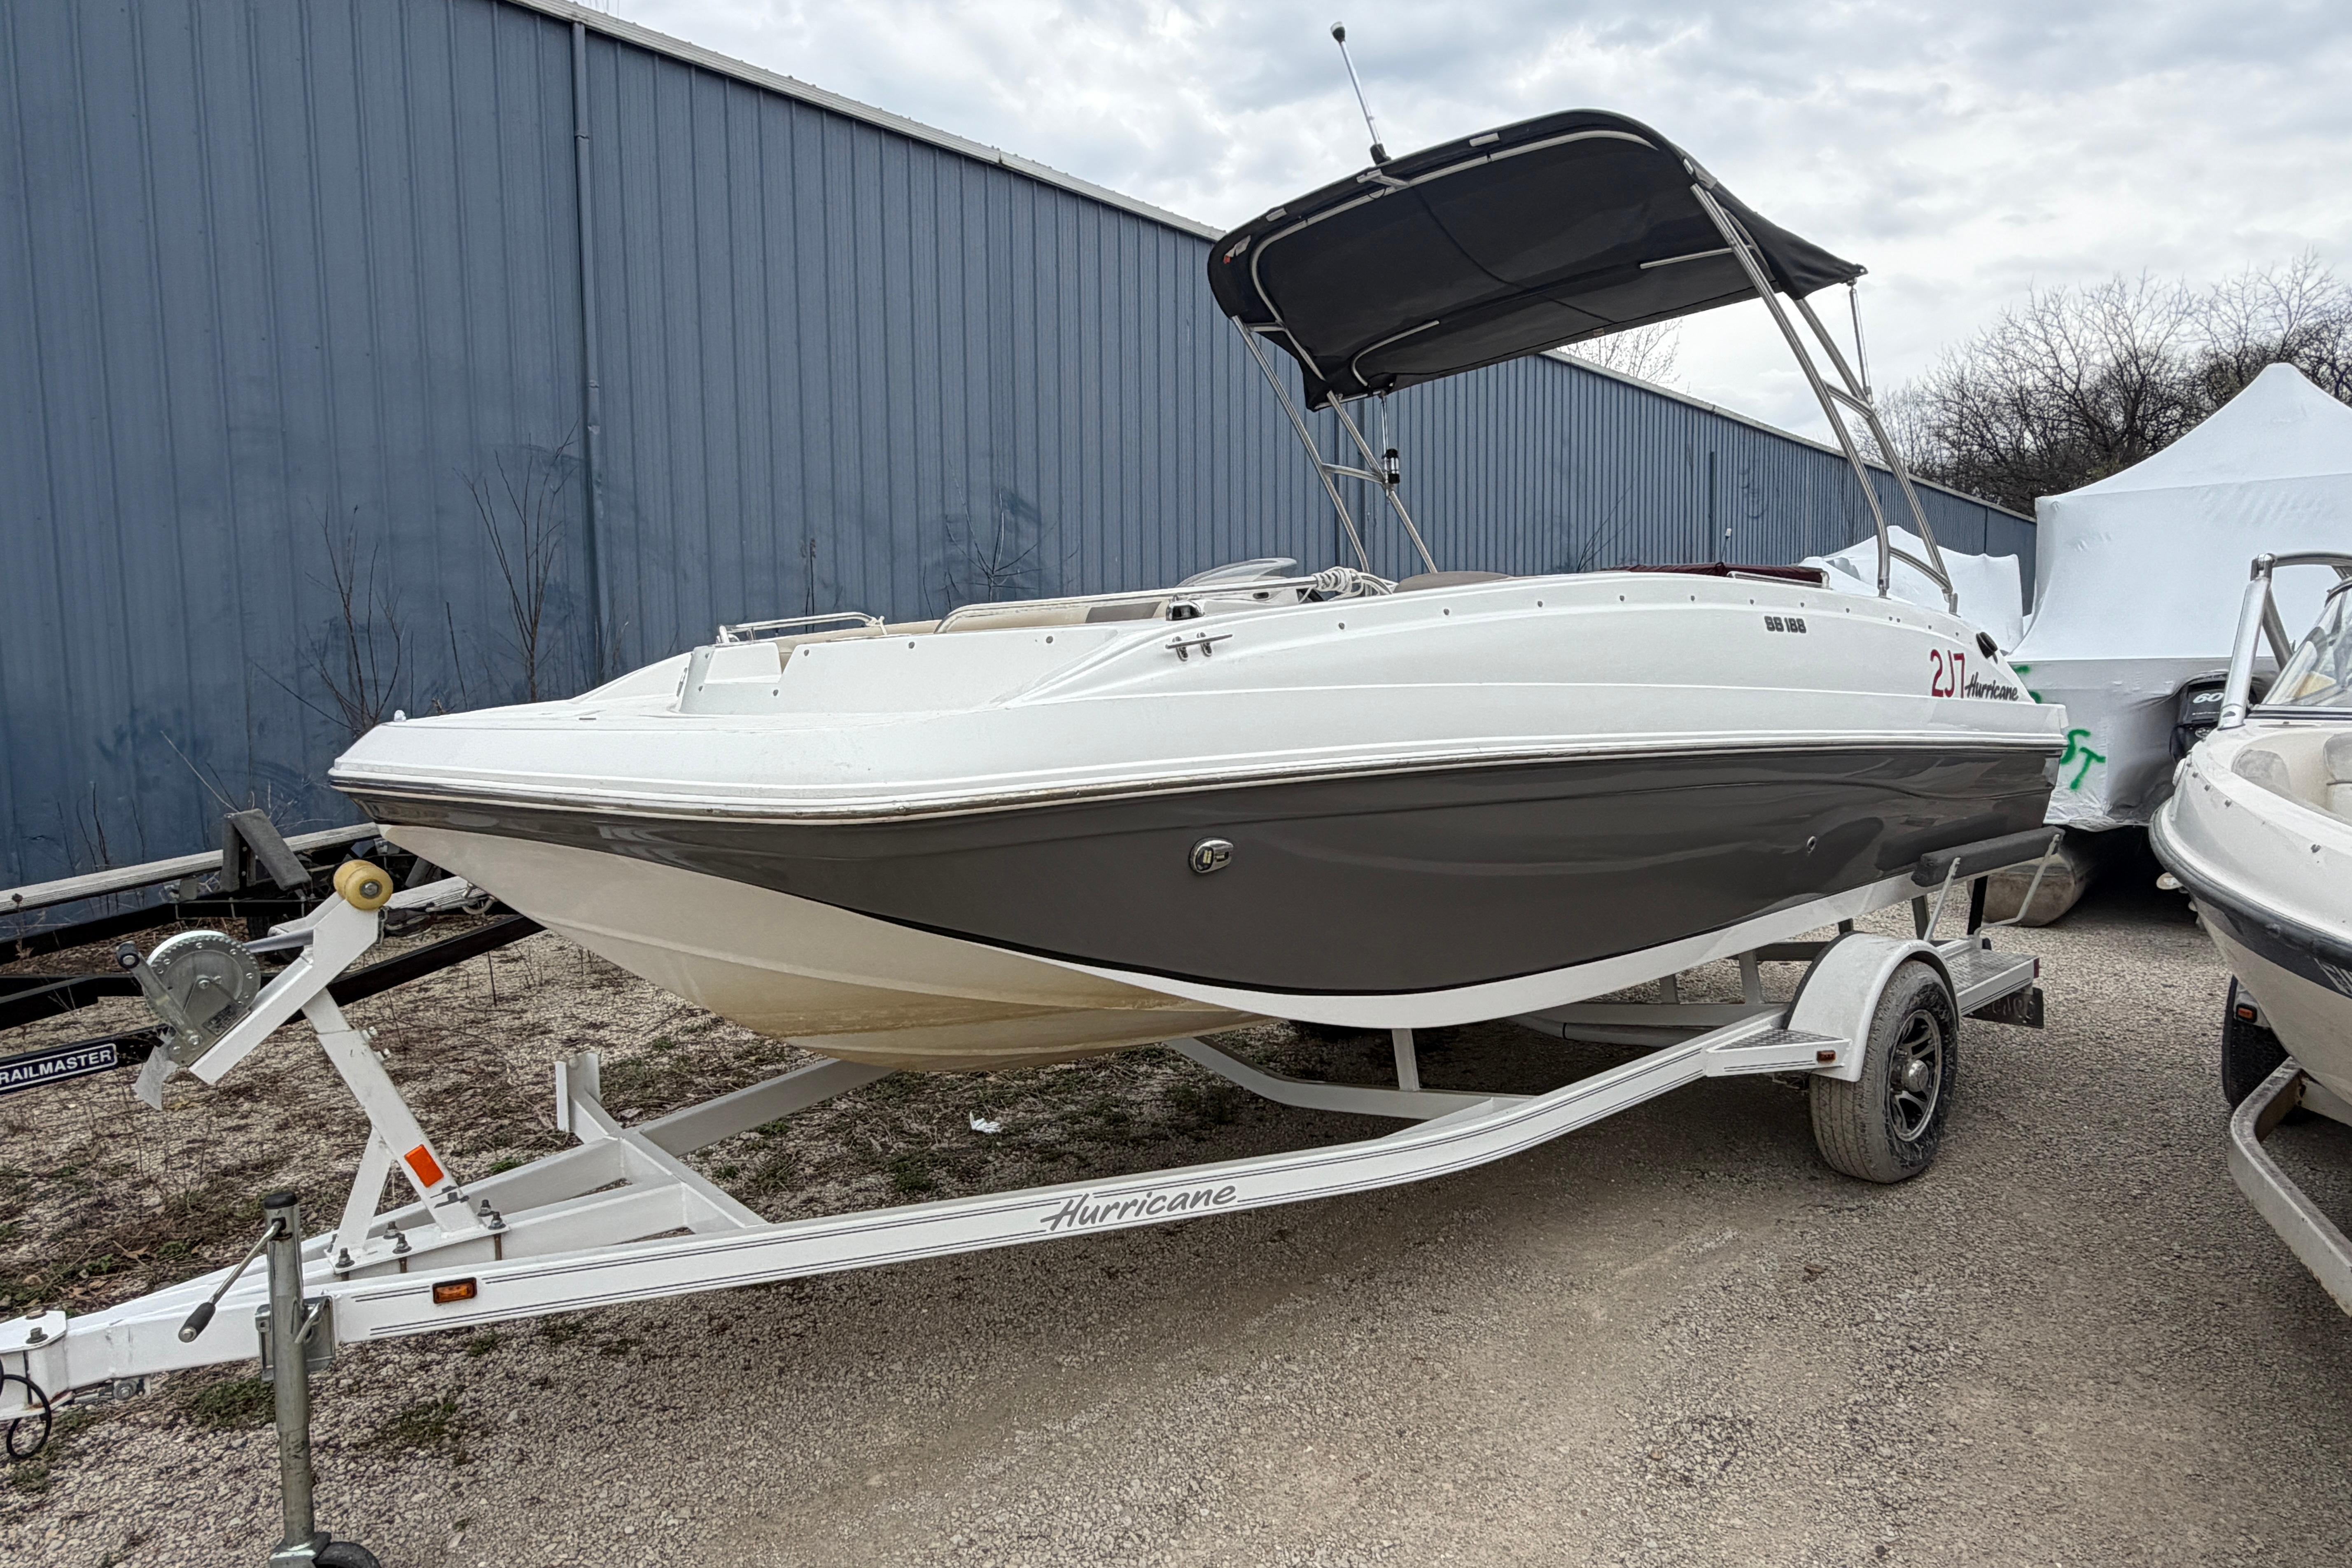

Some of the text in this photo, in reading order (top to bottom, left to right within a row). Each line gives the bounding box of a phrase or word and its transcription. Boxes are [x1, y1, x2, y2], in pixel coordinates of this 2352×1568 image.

[1965, 671, 2019, 701] Hurricane
[2193, 693, 2224, 703] 60
[1040, 1185, 1237, 1231] Hurricane
